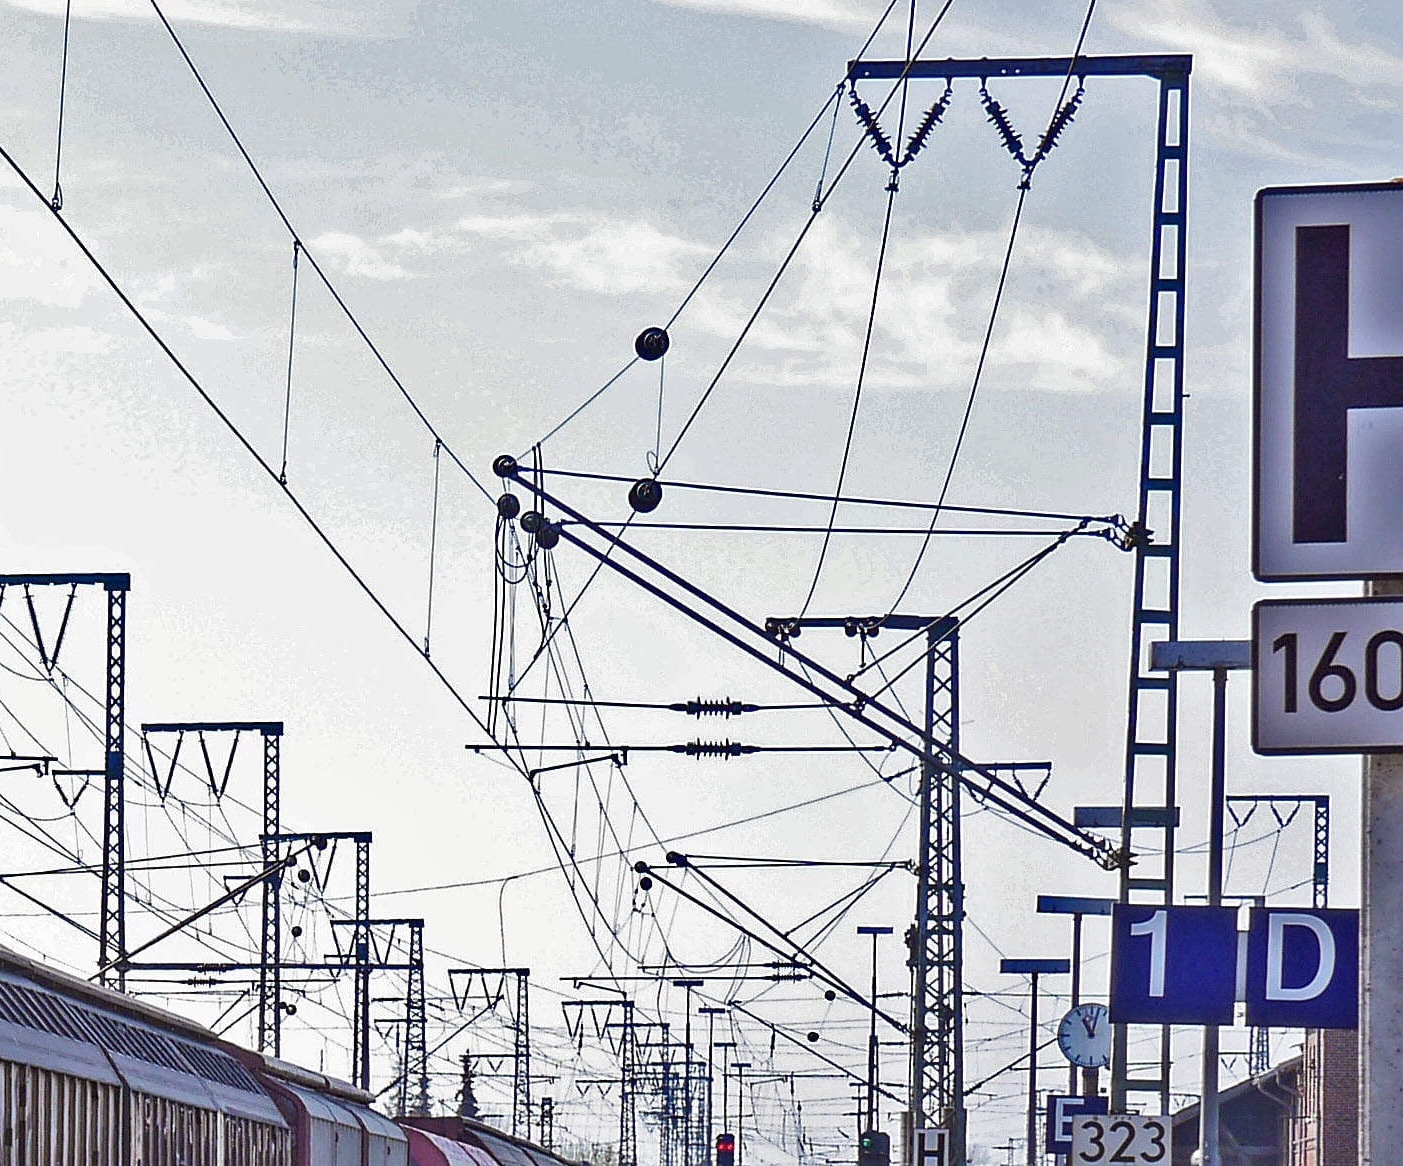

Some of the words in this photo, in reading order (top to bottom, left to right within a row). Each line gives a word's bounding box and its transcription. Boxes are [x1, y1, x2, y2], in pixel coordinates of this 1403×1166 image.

[1272, 629, 1403, 715] 160
[1130, 910, 1168, 998] 1
[1265, 912, 1336, 1001] D
[1079, 1120, 1166, 1163] 323
